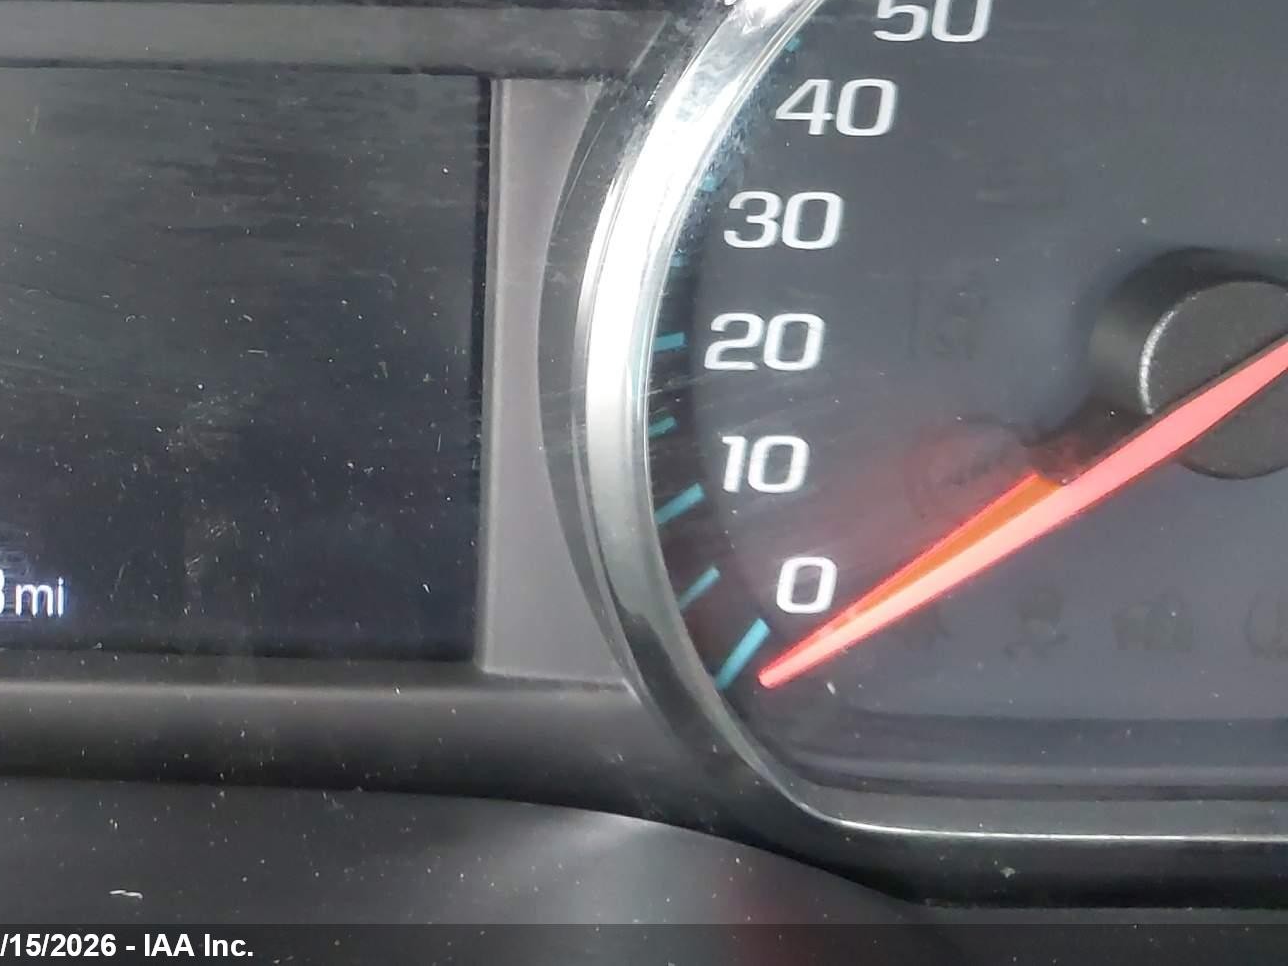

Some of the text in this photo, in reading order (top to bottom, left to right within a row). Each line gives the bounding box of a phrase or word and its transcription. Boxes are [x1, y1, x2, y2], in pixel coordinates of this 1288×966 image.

[776, 79, 896, 136] 40
[724, 191, 842, 249] 30
[705, 313, 824, 370] 20
[722, 436, 808, 493] 10
[777, 557, 837, 613] 0
